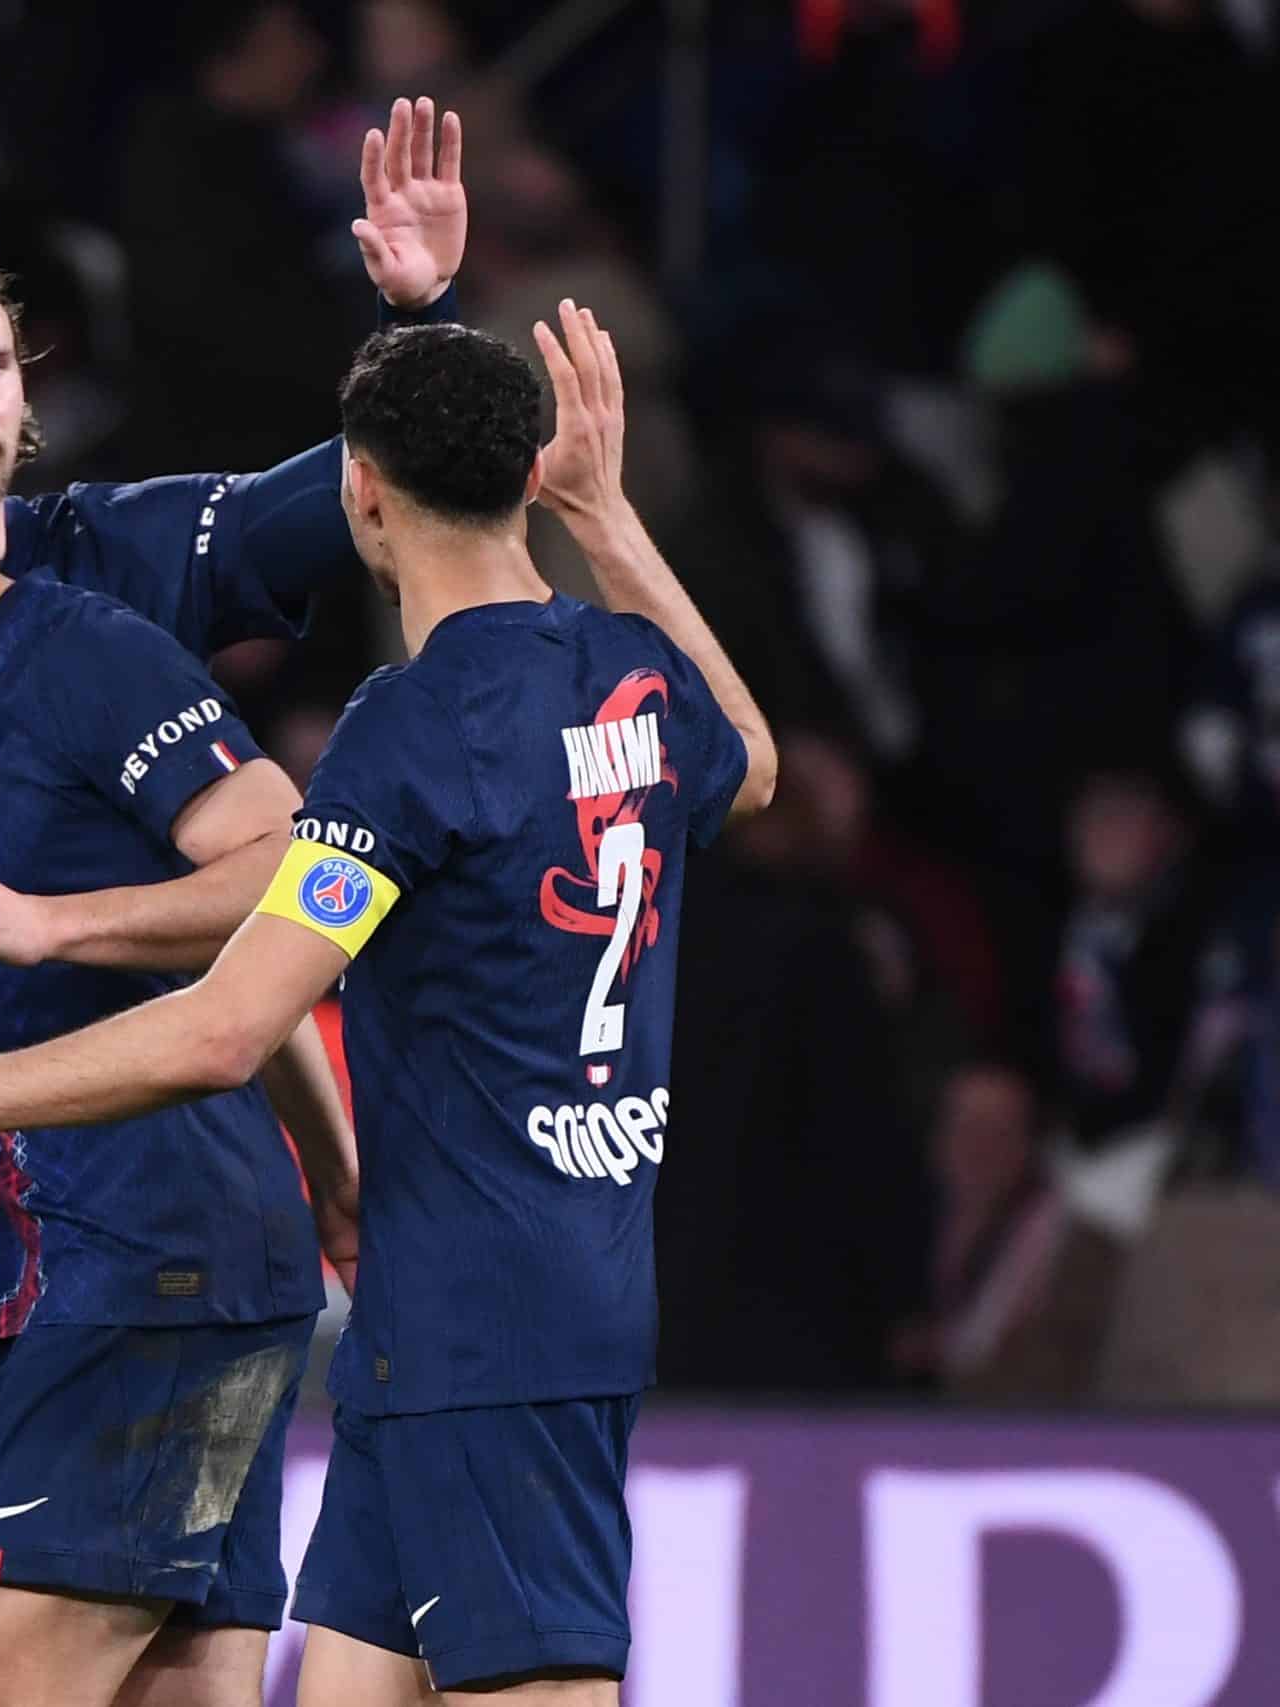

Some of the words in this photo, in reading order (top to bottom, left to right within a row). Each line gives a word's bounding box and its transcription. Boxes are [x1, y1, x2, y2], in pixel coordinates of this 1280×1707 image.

[120, 698, 222, 795] BEYOND
[561, 712, 661, 800] HAKIMI
[322, 862, 367, 890] PARIS
[580, 822, 645, 1056] 2
